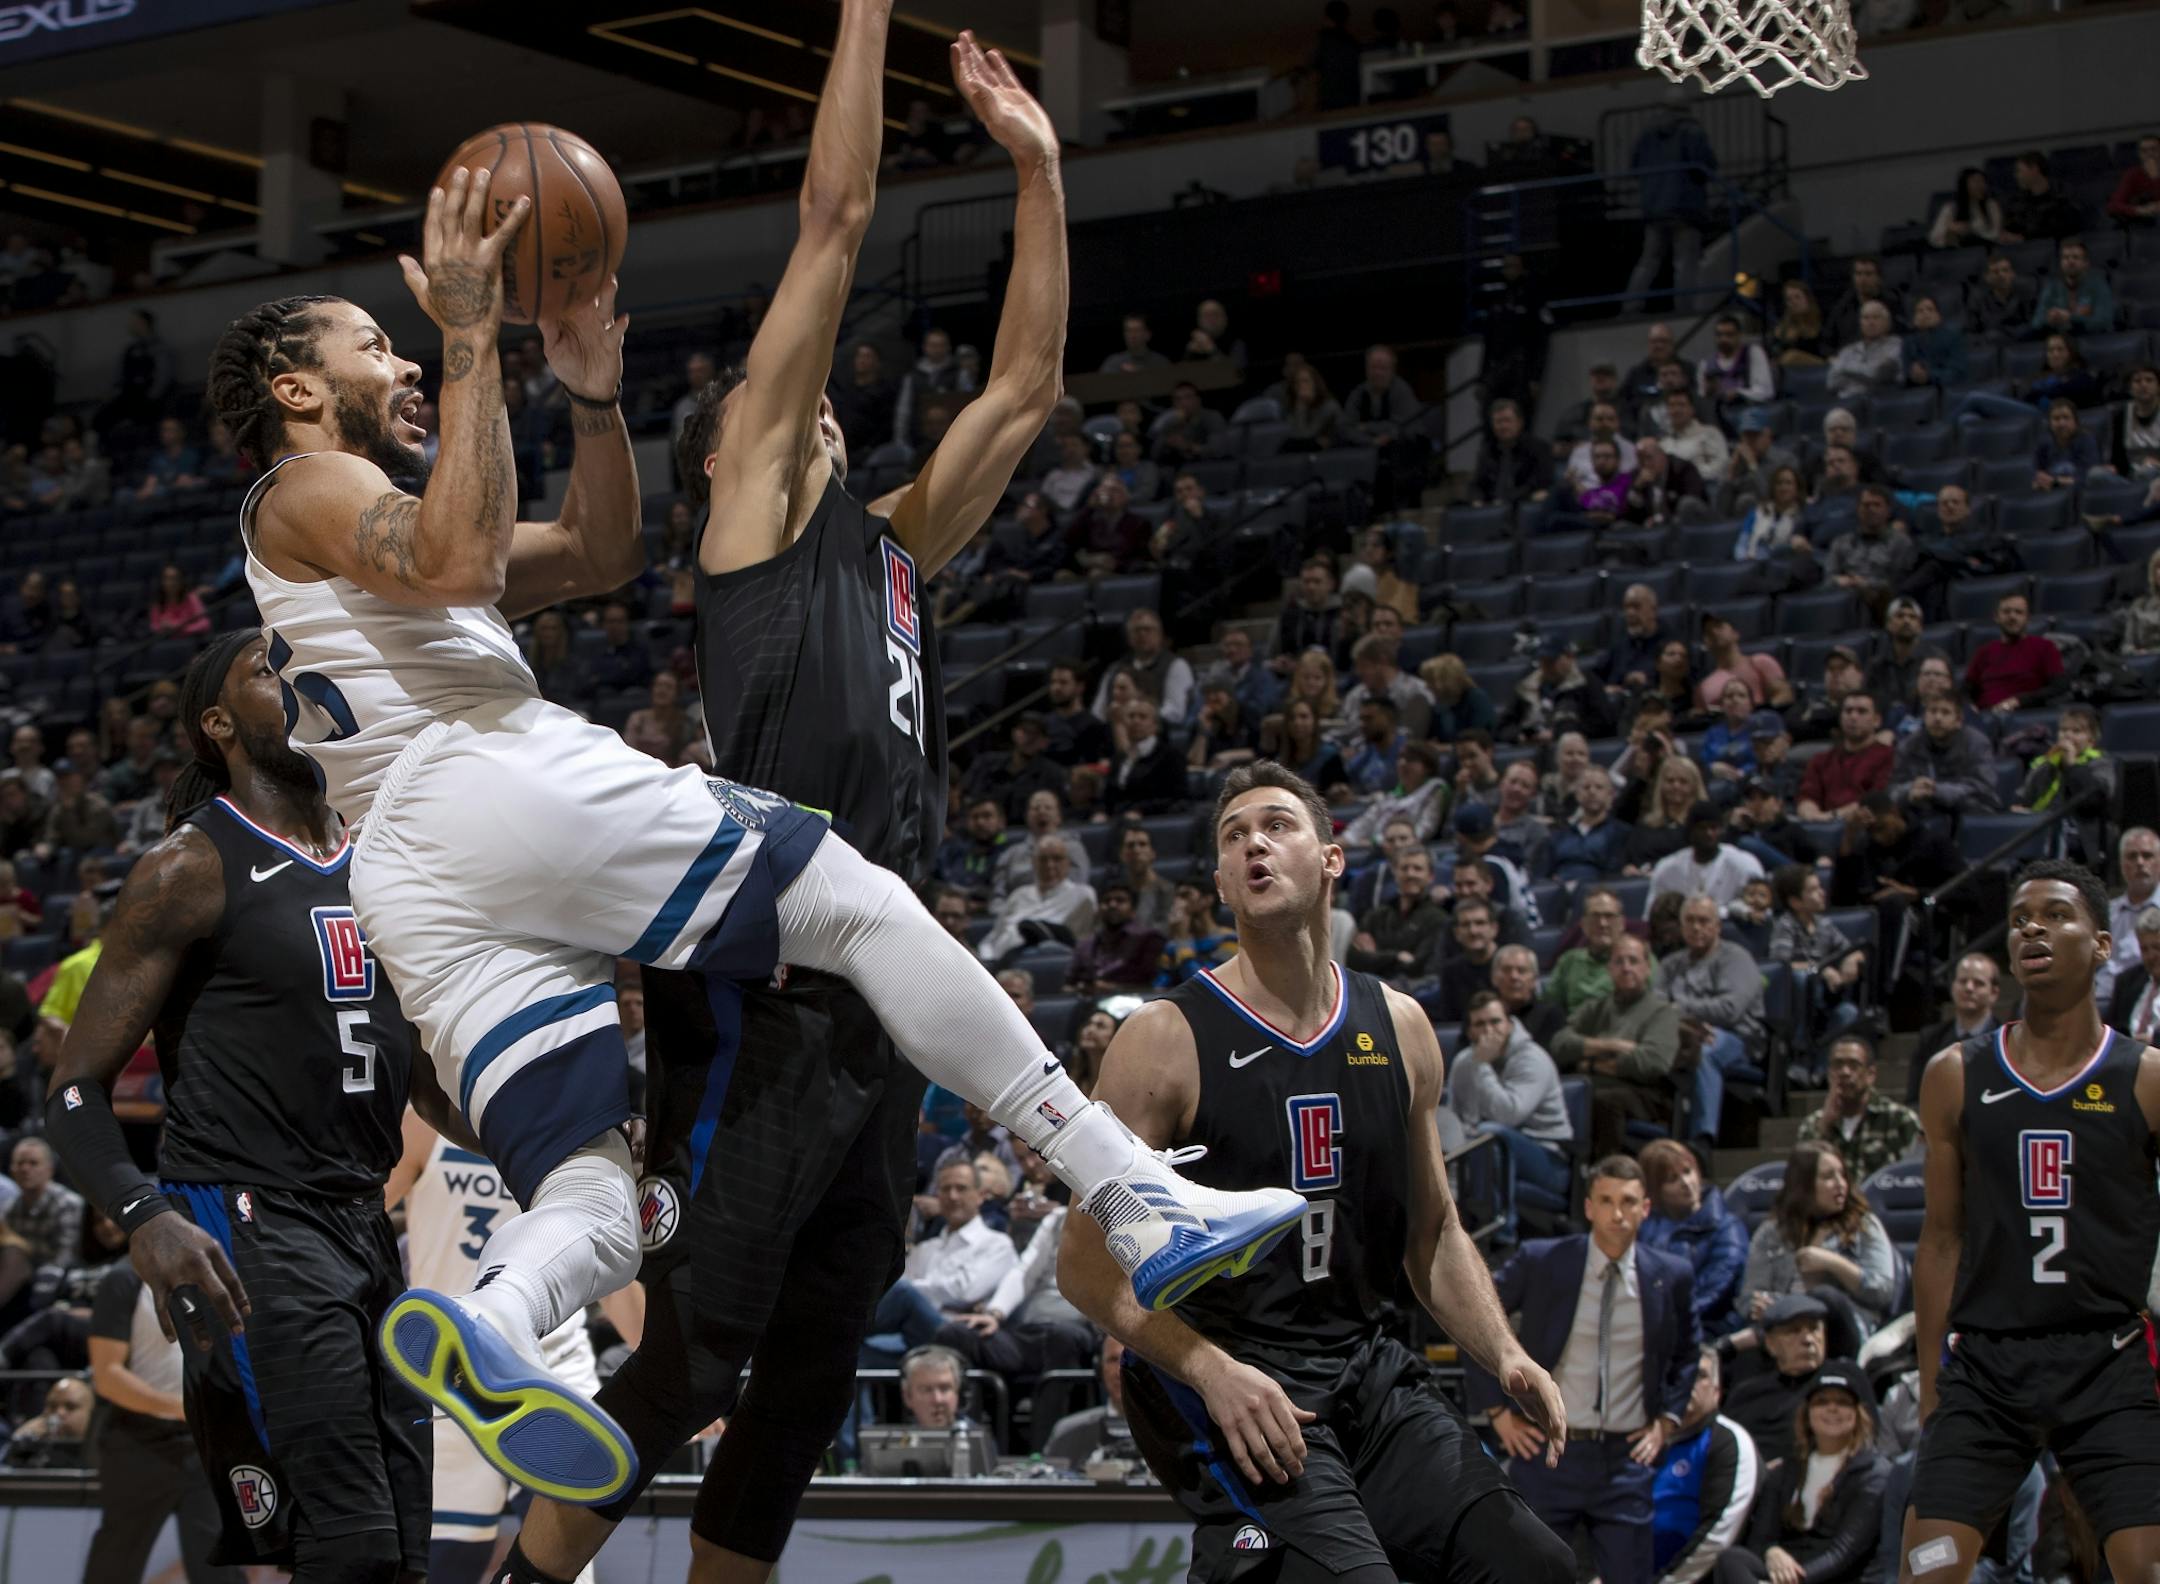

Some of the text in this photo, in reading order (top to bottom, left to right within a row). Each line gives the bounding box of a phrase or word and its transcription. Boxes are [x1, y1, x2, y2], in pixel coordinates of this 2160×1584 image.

[1349, 124, 1417, 166] 130
[886, 633, 925, 756] 20
[336, 1009, 376, 1093] 5
[1347, 1053, 1389, 1066] bumble
[2072, 1099, 2115, 1113] bumble
[459, 1204, 499, 1261] 3
[1301, 1198, 1335, 1283] 8
[2029, 1215, 2067, 1284] 2
